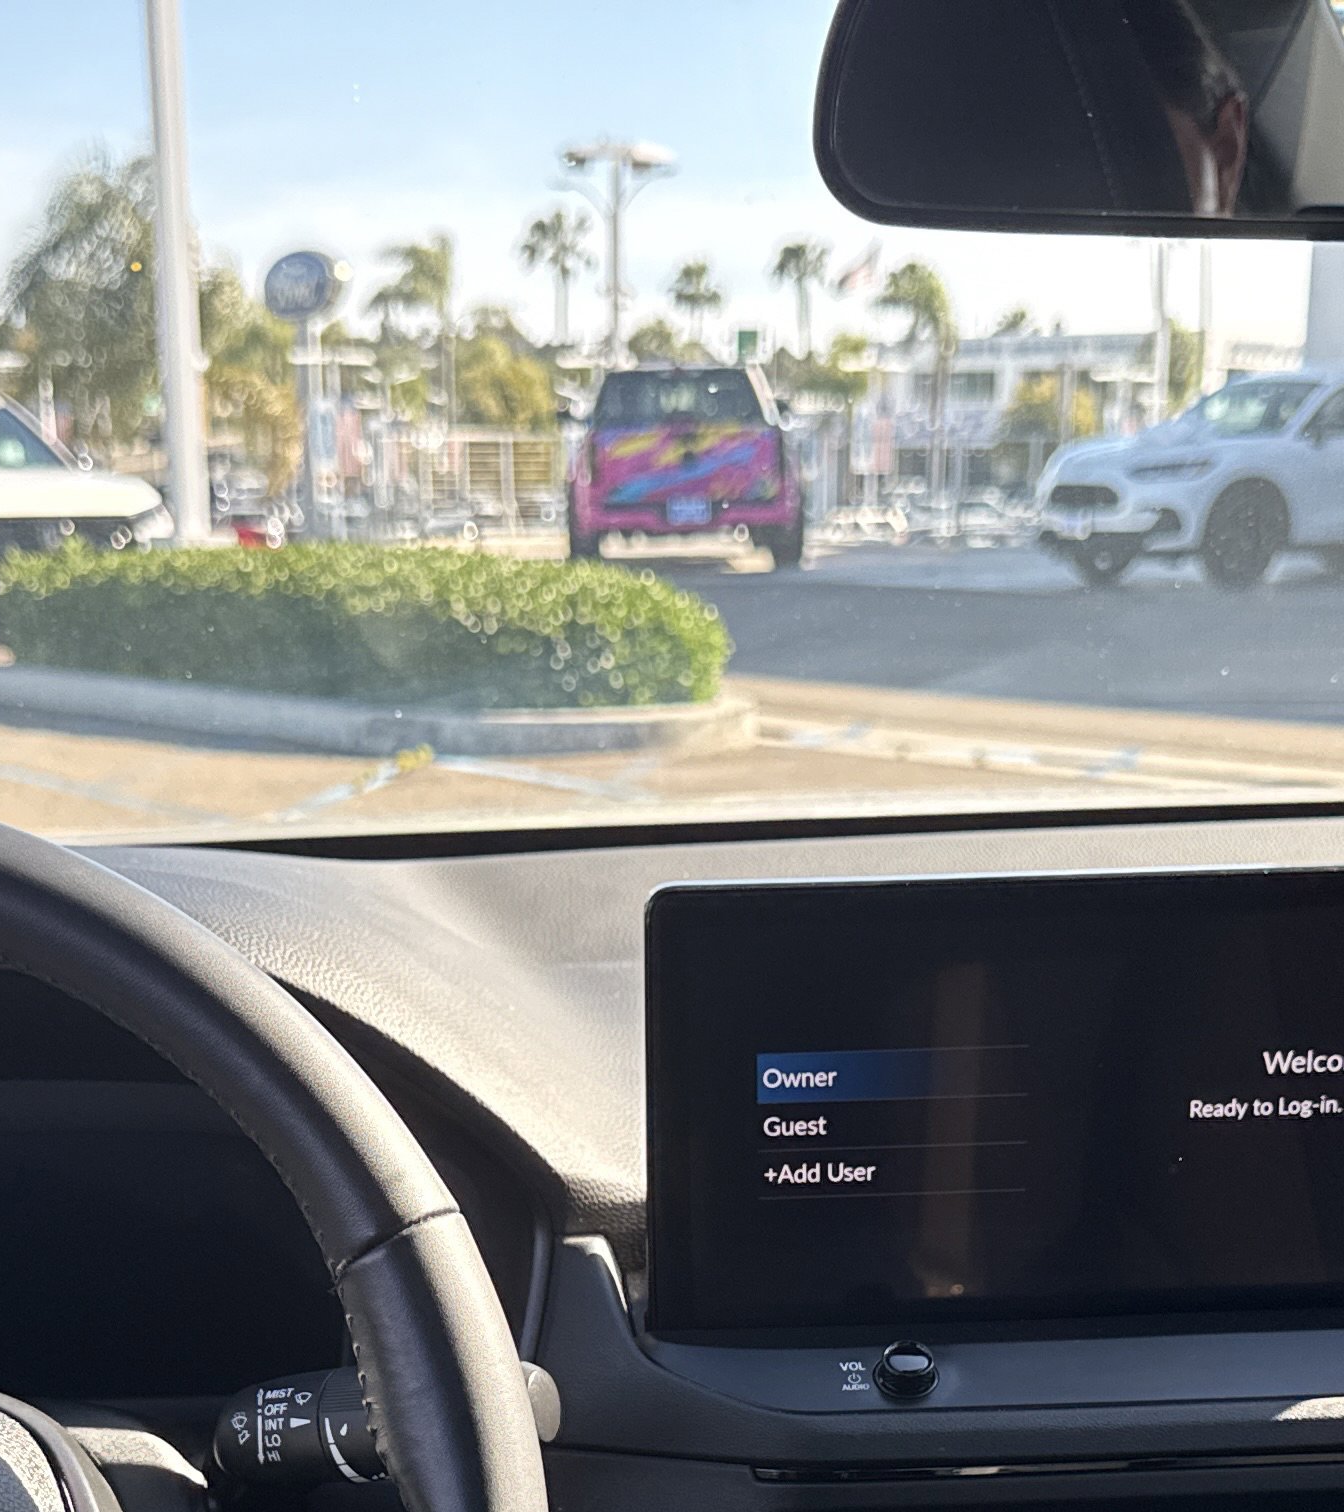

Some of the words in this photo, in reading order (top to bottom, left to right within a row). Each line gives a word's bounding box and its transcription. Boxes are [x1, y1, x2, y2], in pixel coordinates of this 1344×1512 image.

[762, 1067, 838, 1089] Owner
[1189, 1097, 1247, 1121] Ready
[1253, 1099, 1274, 1117] to
[1278, 1095, 1344, 1119] Log-in.
[763, 1116, 828, 1137] Guest
[763, 1162, 821, 1184] +Add
[827, 1162, 877, 1183] User
[839, 1361, 866, 1372] VOL
[264, 1387, 295, 1400] MIST
[841, 1383, 870, 1391] AUDIO
[264, 1402, 289, 1416] OFF
[265, 1417, 285, 1431] INT
[265, 1433, 282, 1448] LO
[267, 1450, 282, 1463] HI
